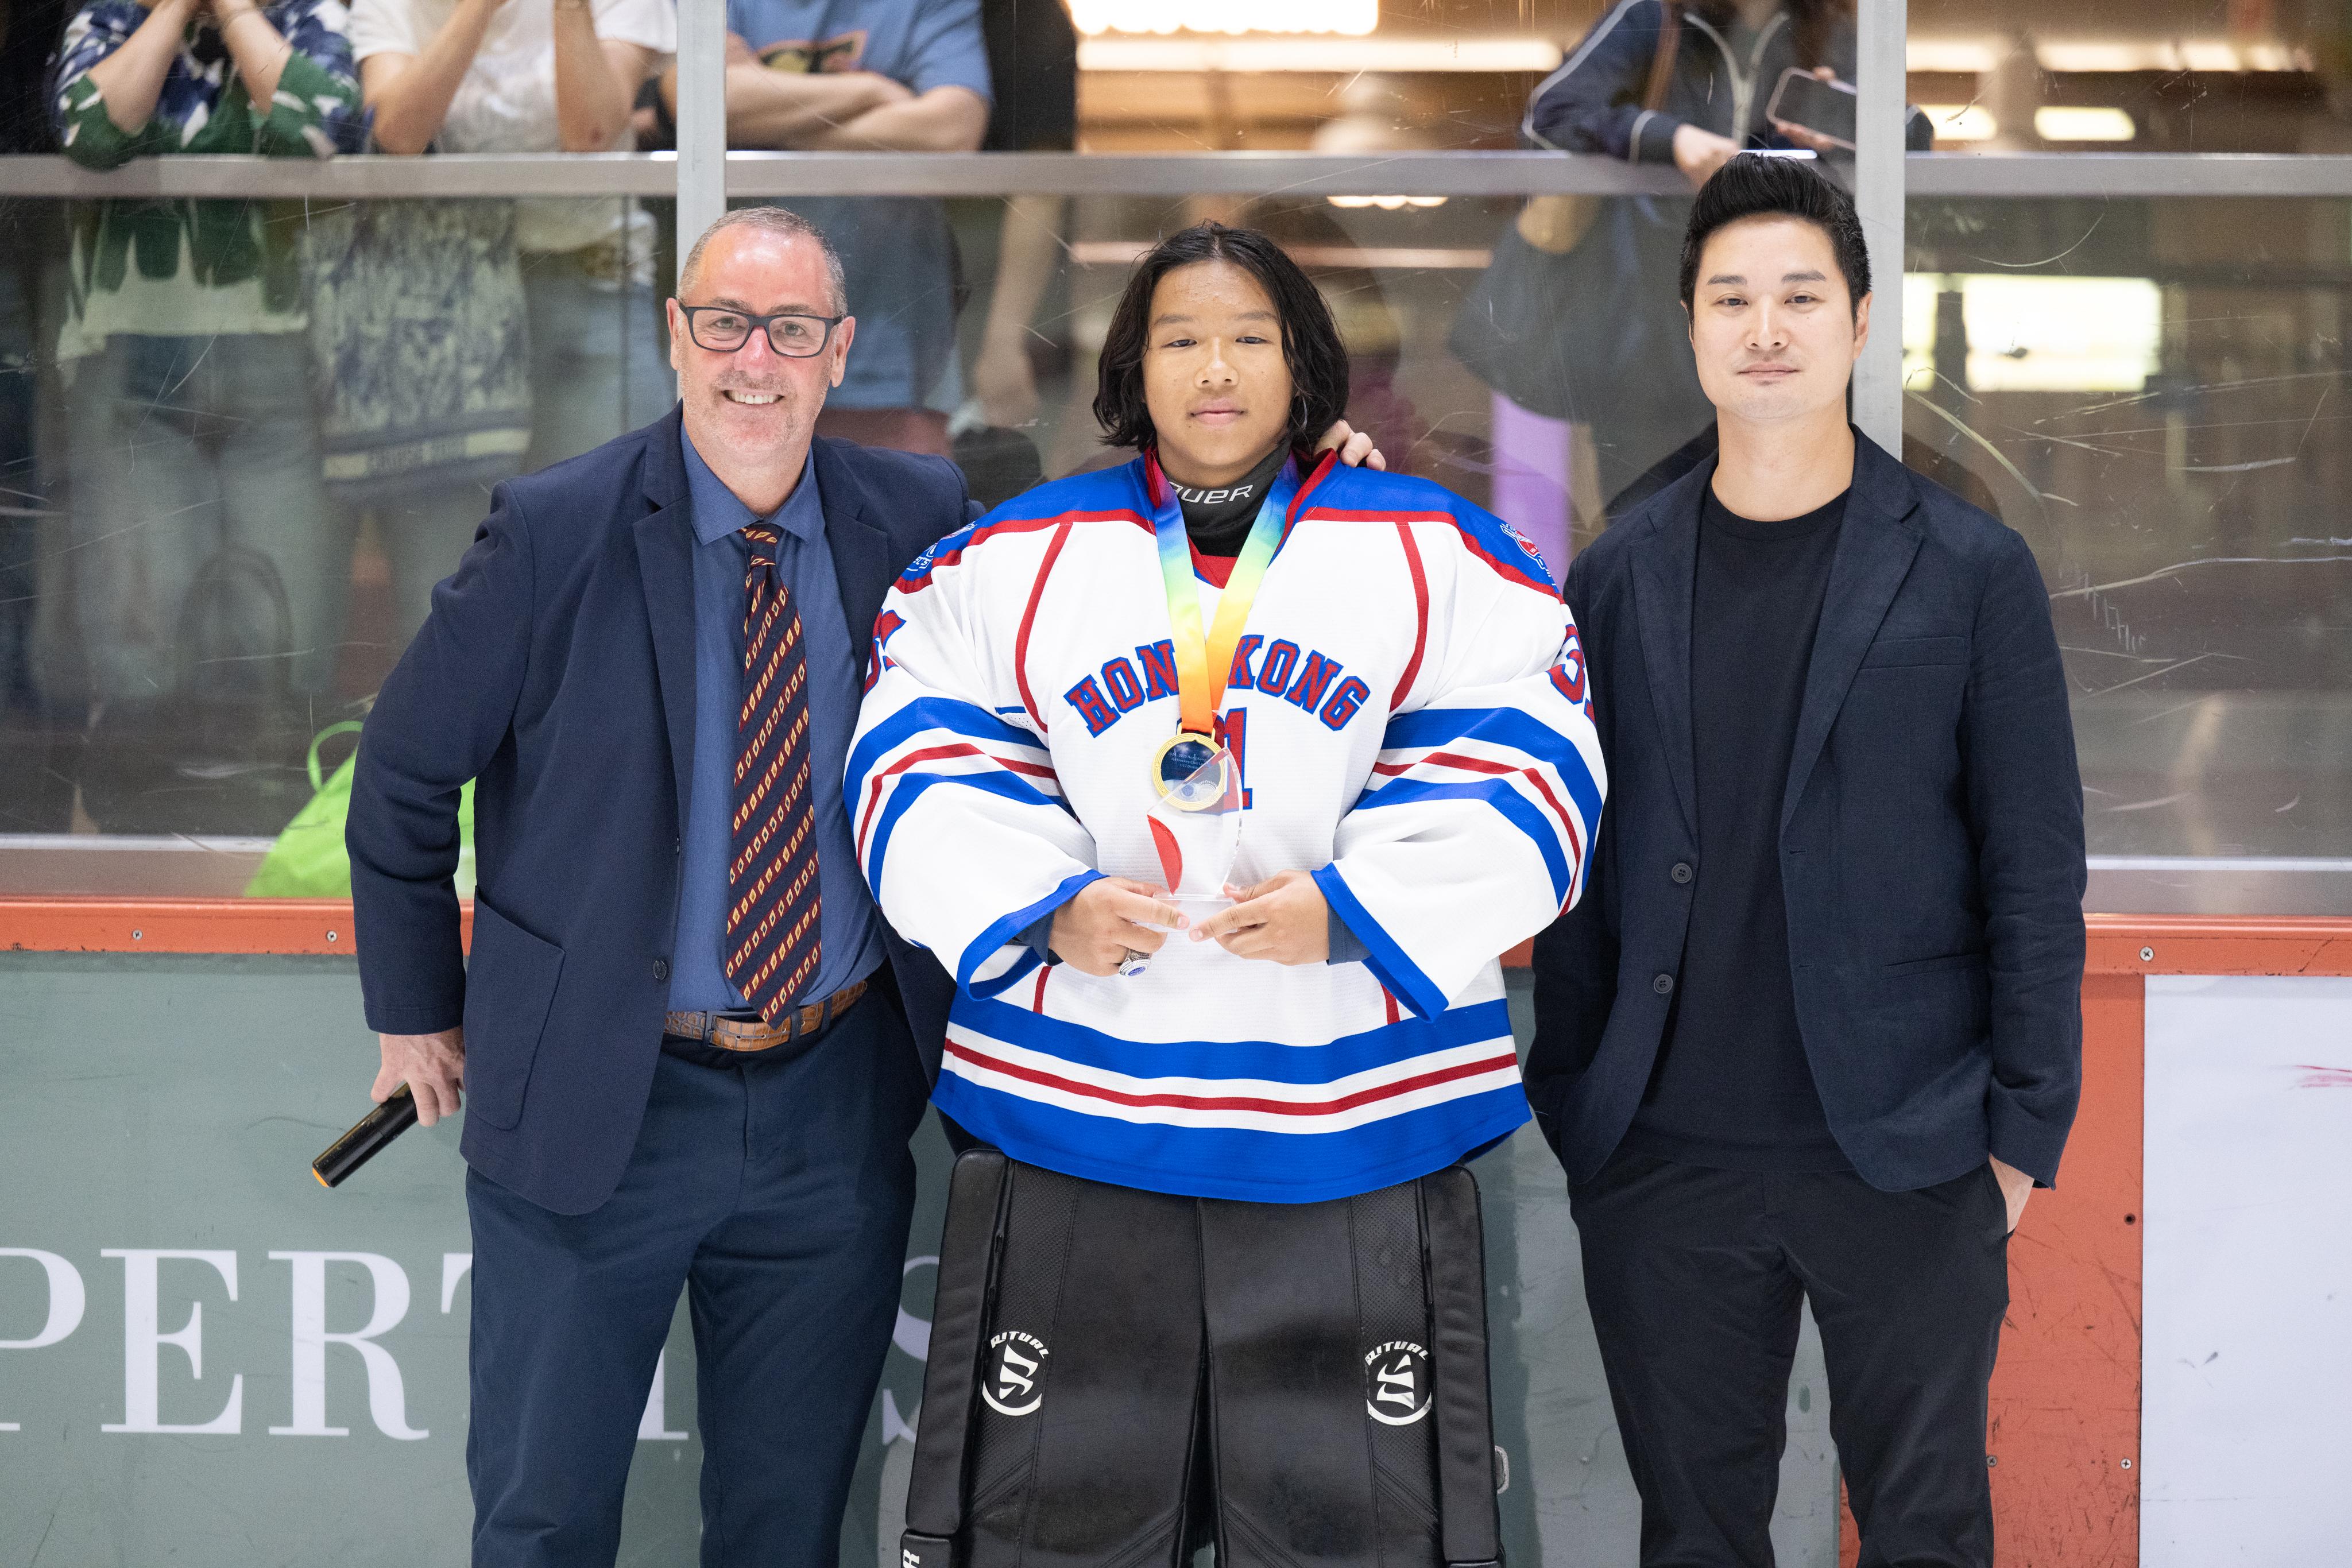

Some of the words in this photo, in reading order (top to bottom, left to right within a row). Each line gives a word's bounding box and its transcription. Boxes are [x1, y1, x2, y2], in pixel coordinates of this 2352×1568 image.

[1169, 481, 1254, 504] AUER
[1063, 638, 1179, 738] HON
[1227, 634, 1371, 731] KONG
[991, 1331, 1049, 1359] RITUAL
[1364, 1341, 1429, 1366] RITUAL
